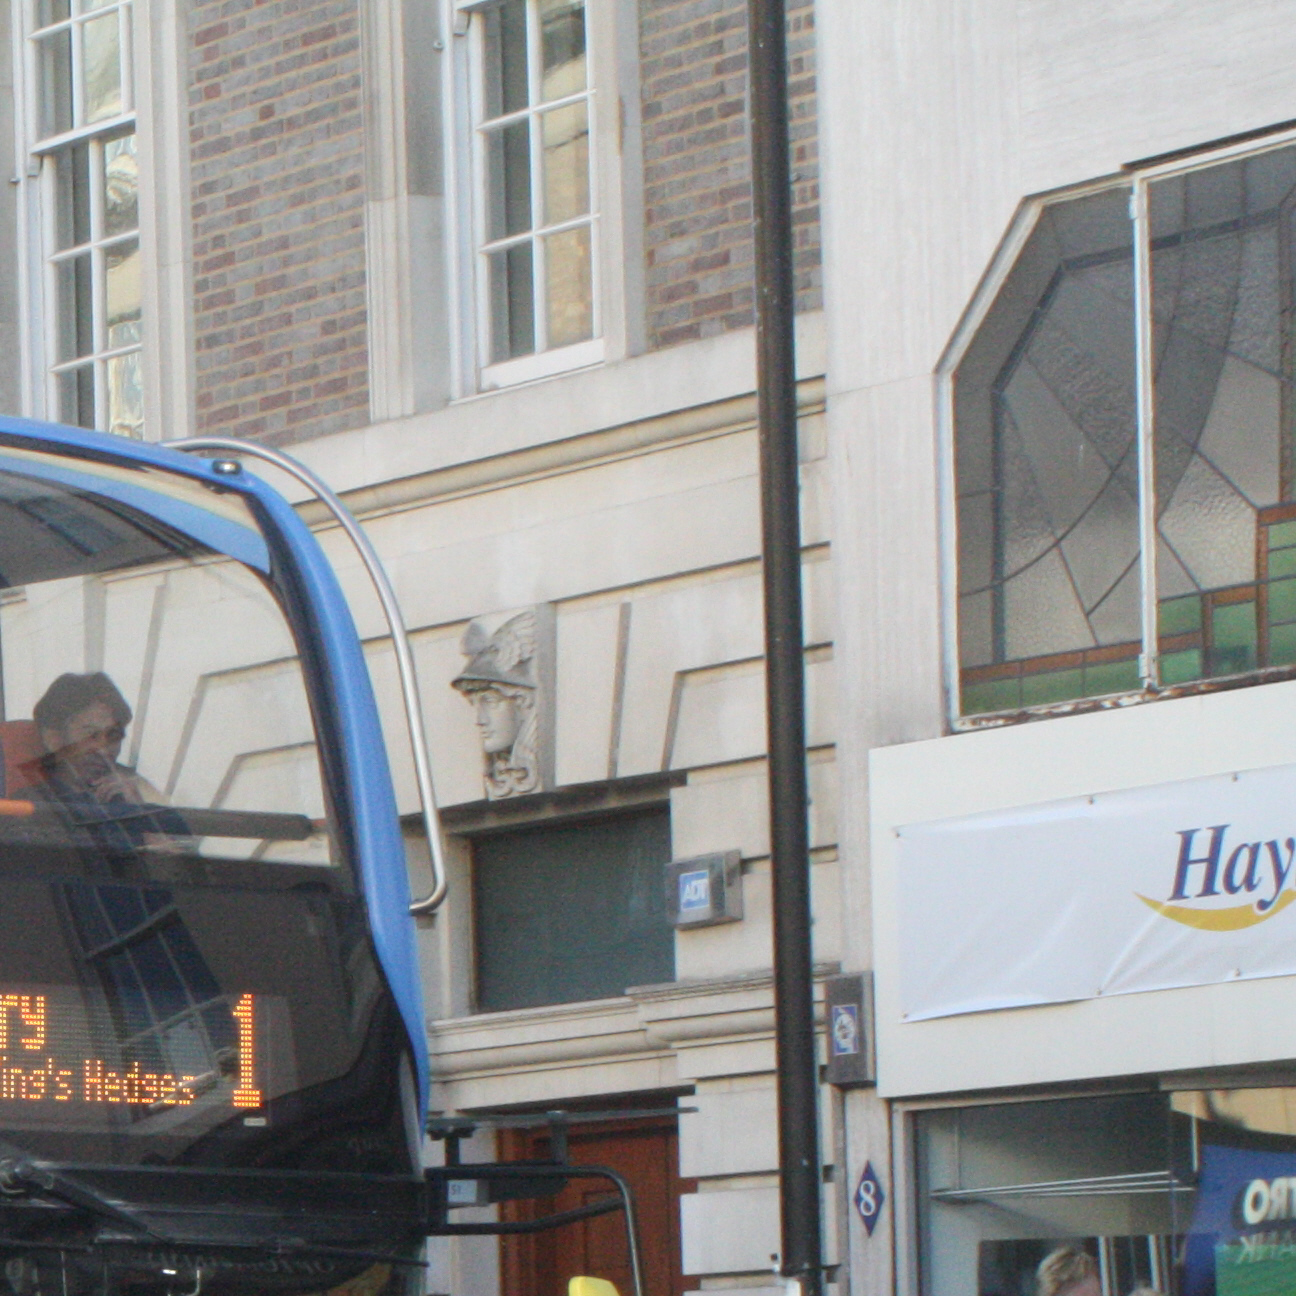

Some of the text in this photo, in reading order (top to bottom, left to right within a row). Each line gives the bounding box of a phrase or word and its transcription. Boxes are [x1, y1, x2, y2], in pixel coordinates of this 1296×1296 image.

[1167, 824, 1296, 911] Hay
[84, 1059, 197, 1105] Hedges
[233, 993, 261, 1107] 1
[860, 1180, 877, 1217] 8
